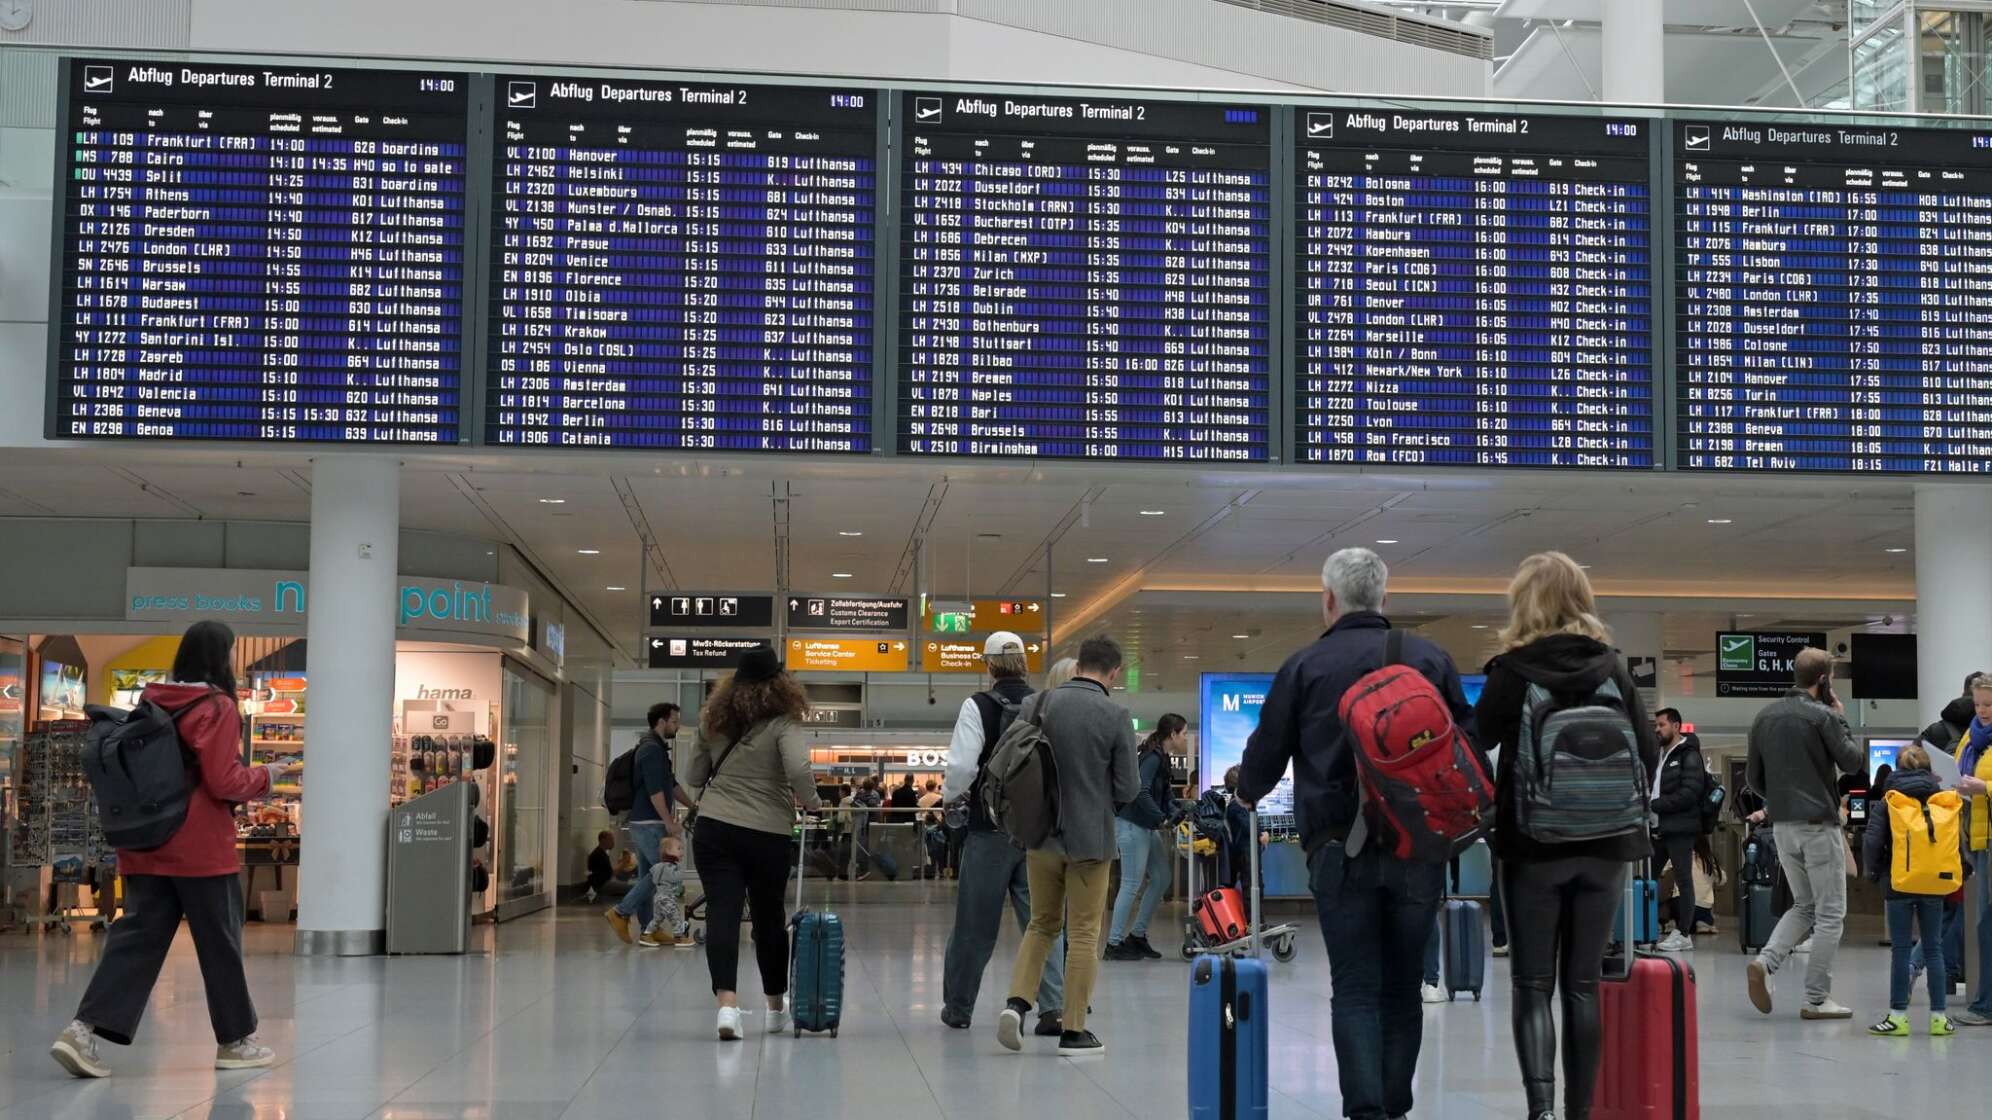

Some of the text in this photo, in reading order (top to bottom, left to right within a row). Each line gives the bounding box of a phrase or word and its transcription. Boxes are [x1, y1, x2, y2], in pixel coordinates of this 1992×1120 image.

[128, 67, 454, 91] Abflug Departures Terminal 2 14:00
[550, 83, 863, 107] Abflug Departures Terminal 2 14:00
[956, 99, 1144, 120] Abflug Departures Terminal 2
[1346, 114, 1636, 136] Abflug Departures Terminal 2 14:00
[1723, 127, 1897, 145] Abflug Departures Terminal 2
[148, 152, 346, 170] Cairo 14:10 14:35
[570, 149, 855, 170] Hanover 15:15 Lufthansa
[569, 167, 622, 180] Helsinki
[147, 170, 437, 191] Split 14:25 boarding
[1366, 177, 1624, 196] Bologna 16:00 Check-in
[569, 184, 637, 198] Luxembourg
[975, 181, 1250, 202] Dusseldorf 15:30 Lufthansa
[146, 188, 444, 209] Athens Lufthansa
[1366, 194, 1404, 206] Boston
[145, 206, 209, 219] Paderborn
[1743, 205, 1877, 221] Berlin 17:00
[145, 224, 194, 237] Dresden
[1366, 228, 1410, 240] Hamburg
[568, 237, 608, 249] Prague
[974, 232, 1027, 246] Debrecen
[1743, 239, 1786, 251] Hamburg
[1366, 245, 1429, 258] Kopenhagen
[567, 255, 608, 267] Venice
[1743, 256, 1780, 267] Lisbon
[143, 260, 441, 280] Brussels Lufthansa
[974, 267, 1013, 279] Zurich
[567, 272, 853, 292] Florence 15:20 Lufthansa
[566, 290, 600, 302] Olbia
[974, 285, 1026, 297] Belgrade
[142, 296, 198, 309] Budapest
[973, 302, 1013, 314] Dublin
[1366, 296, 1404, 308] Denver
[566, 307, 627, 321] Timisoara
[973, 320, 1039, 332] Gothenburg
[1744, 322, 1804, 335] Dusseldorf
[1366, 330, 1423, 342] Marseille
[973, 337, 1031, 350] Stuttgart
[1744, 339, 1787, 351] Cologne
[140, 350, 183, 363] Zagreb
[564, 361, 605, 373] Vienna
[973, 354, 1249, 373] Bilbao 15:50 16:00 Lufthansa
[139, 369, 182, 381] Madrid
[972, 372, 1012, 384] Bremen
[1745, 373, 1787, 384] Hanover
[564, 379, 625, 391] Amsterdam
[1367, 381, 1398, 393] Nizza
[139, 387, 196, 400] Valencia
[972, 389, 1011, 401] Naples
[1745, 389, 1880, 403] Turin 17:55
[563, 396, 625, 409] Barcelona
[1367, 399, 1627, 415] Toulouse 16:10 Check-in
[138, 405, 338, 421] Geneva 15:15 15:30
[972, 406, 997, 418] Bari
[563, 414, 604, 427] Berlin
[1367, 416, 1392, 427] Lyon
[137, 423, 173, 435] Genoa
[972, 424, 1024, 436] Brussels
[1746, 423, 1782, 434] Geneva
[562, 432, 610, 445] Catania
[1367, 433, 1450, 445] San Francisco
[971, 442, 1037, 454] Birmingham
[1746, 440, 1783, 451] Bremen
[1746, 456, 1795, 468] Tel Aviv
[132, 593, 189, 612] press
[194, 593, 262, 612] books
[401, 581, 491, 624] point
[692, 640, 761, 648] MwSt-Rückerstattun
[1758, 636, 1784, 644] Security
[417, 684, 473, 700] hama
[907, 750, 949, 766] BOS
